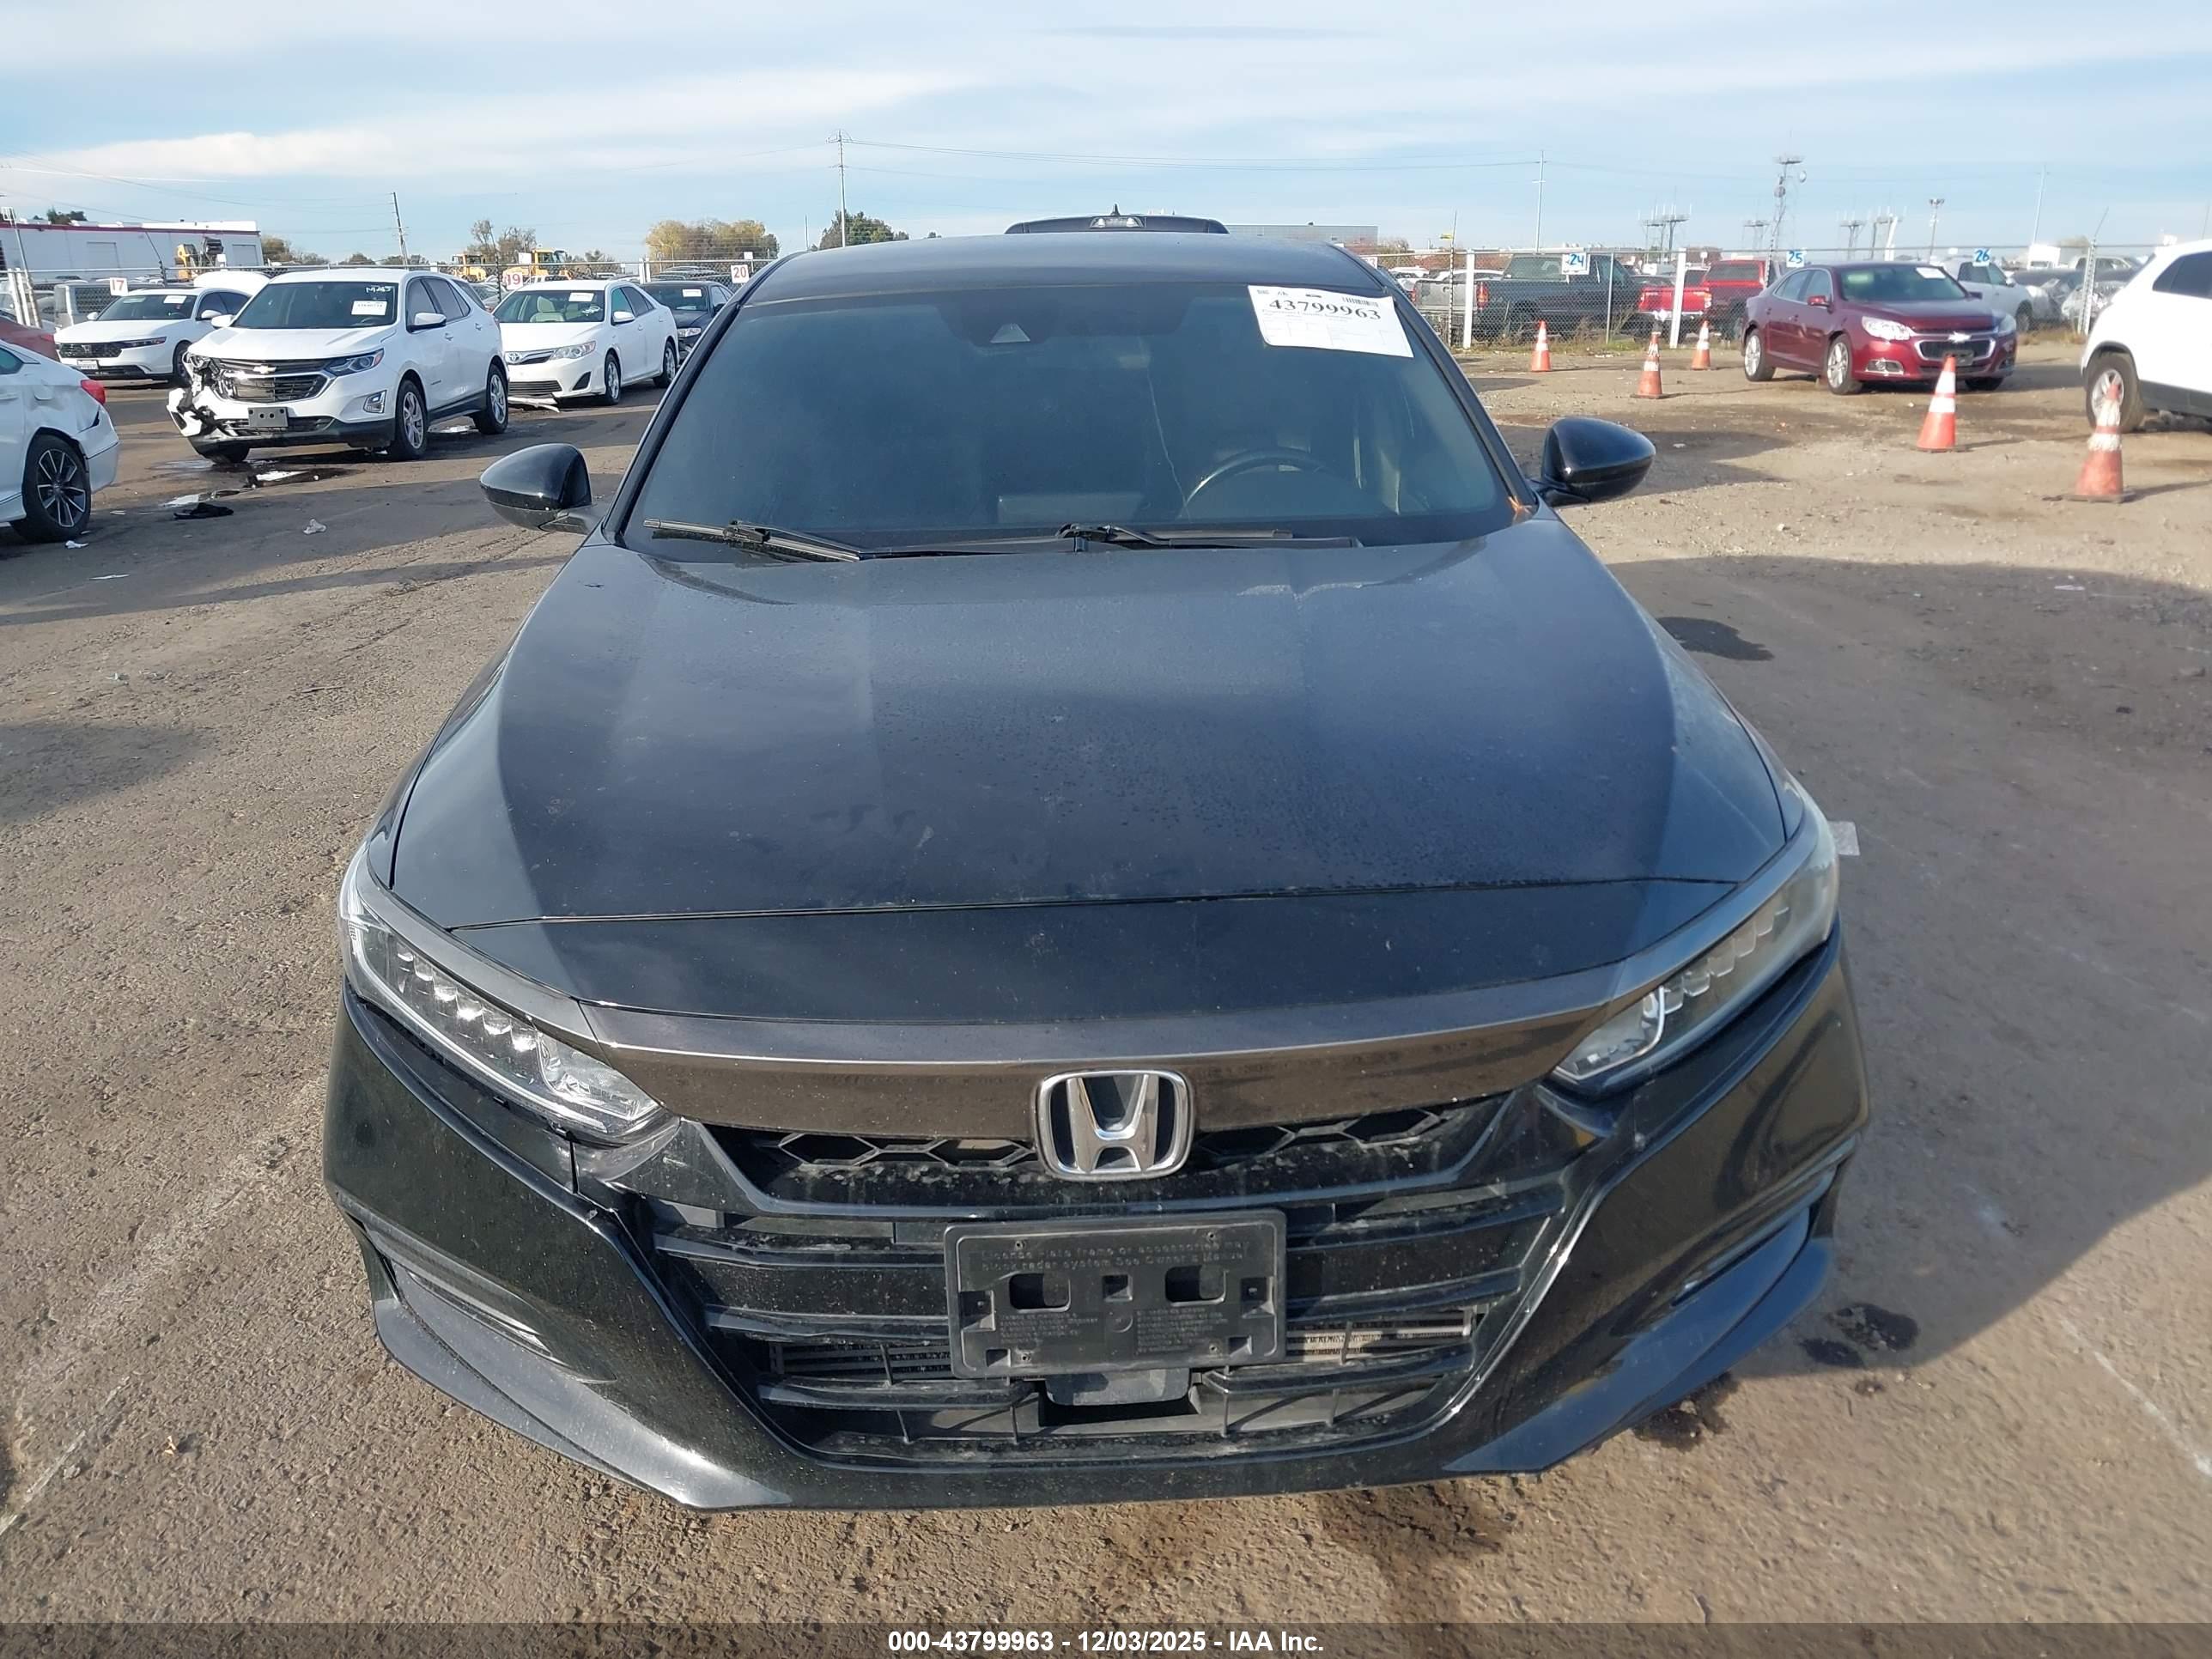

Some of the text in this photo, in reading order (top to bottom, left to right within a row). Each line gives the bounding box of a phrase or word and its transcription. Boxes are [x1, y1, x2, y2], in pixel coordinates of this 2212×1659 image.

[1569, 254, 1585, 269] 24
[1788, 251, 1803, 264] 25
[1975, 249, 1990, 263] 26
[732, 265, 748, 279] 20
[112, 279, 125, 293] 17
[507, 273, 521, 286] 19
[1269, 298, 1381, 320] 43799963
